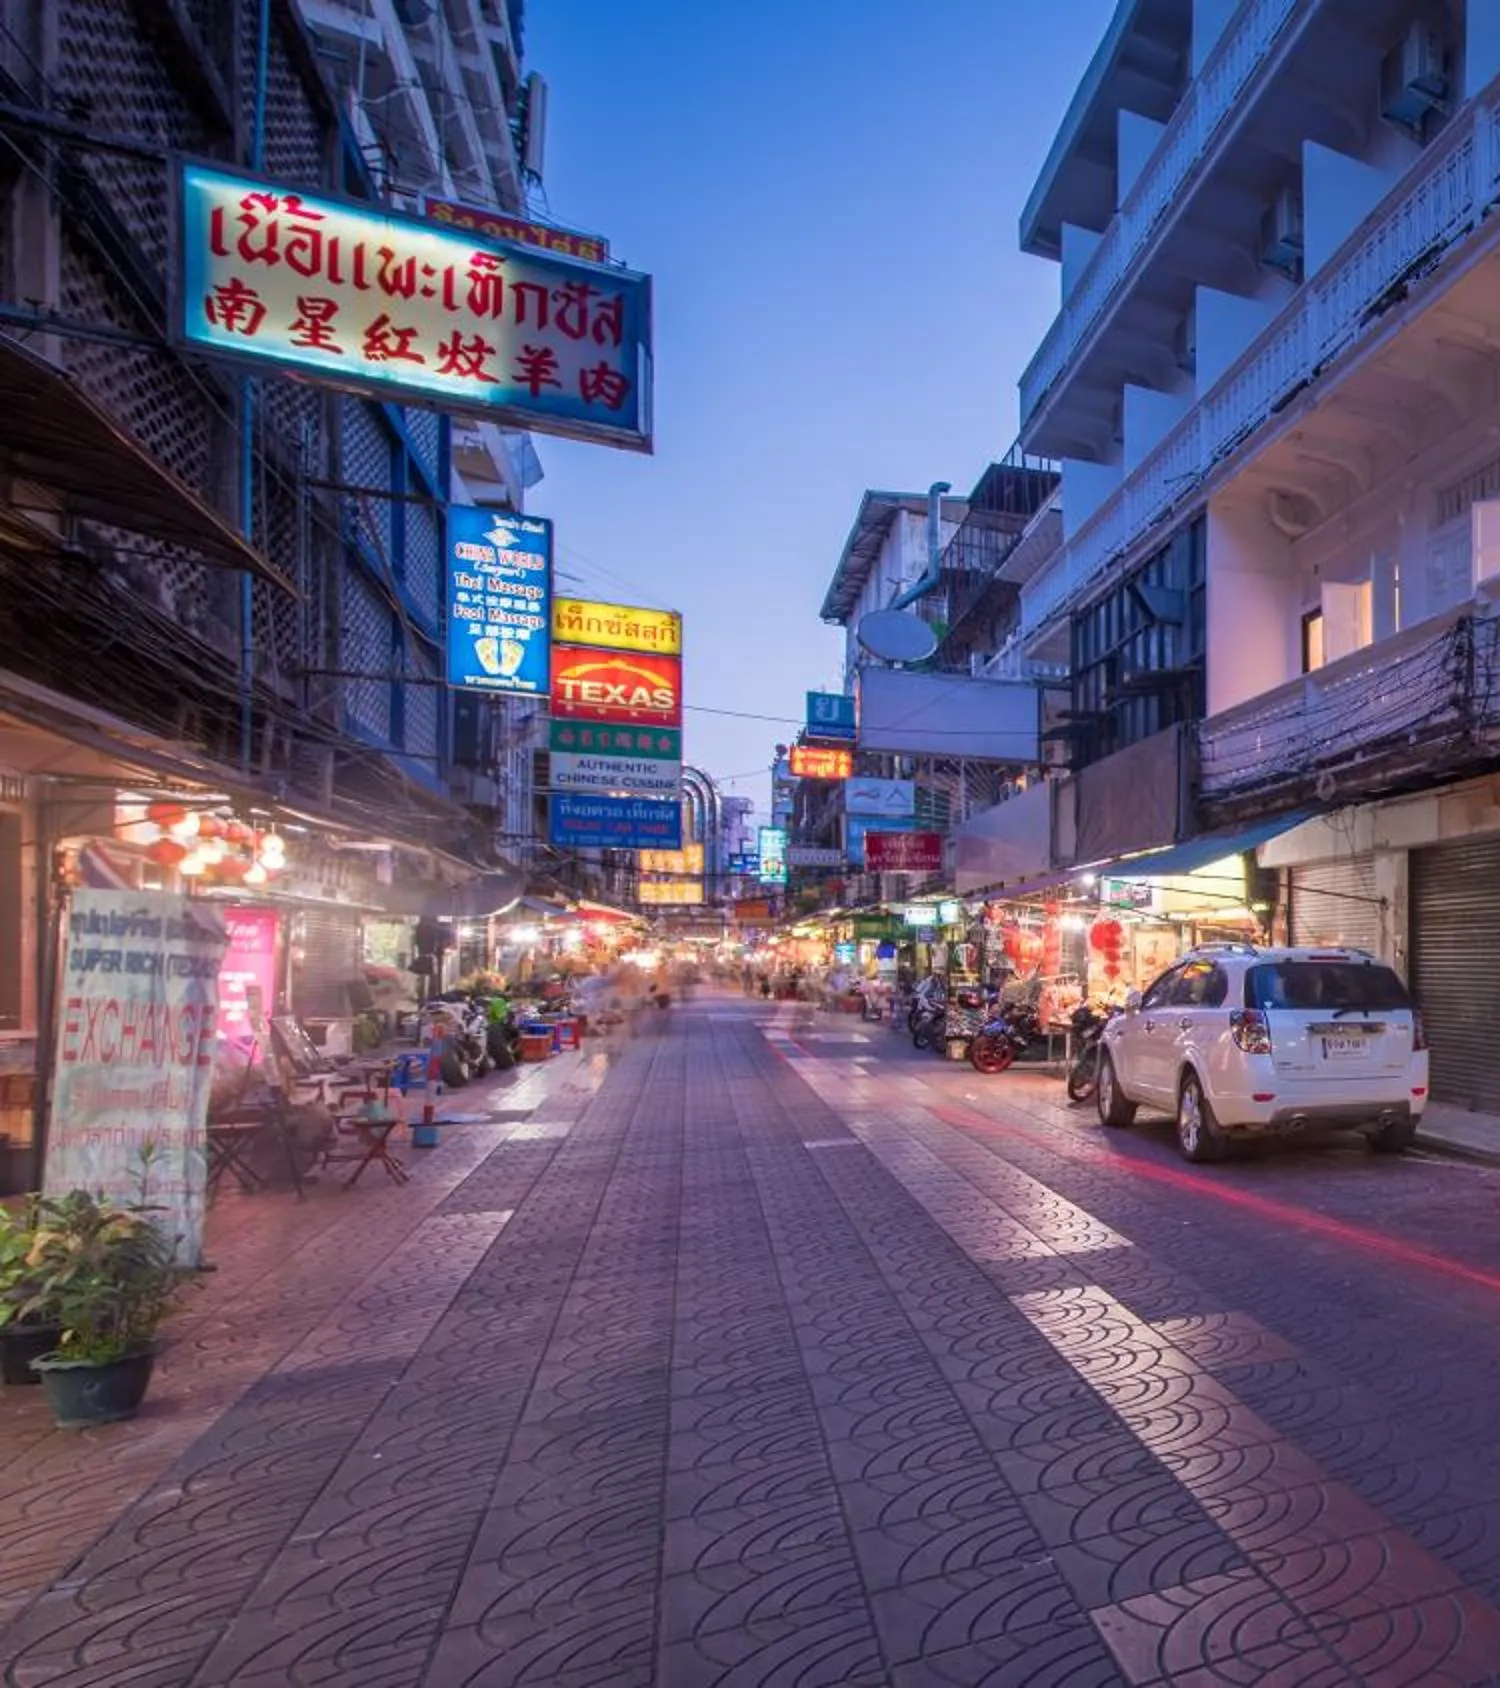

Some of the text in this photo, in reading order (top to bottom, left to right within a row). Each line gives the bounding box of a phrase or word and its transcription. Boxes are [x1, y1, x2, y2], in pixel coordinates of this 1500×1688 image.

[209, 192, 626, 349] เนื้อแพะเท็กซัส
[454, 571, 545, 600] Thai Massage
[487, 607, 546, 631] Massage
[557, 677, 675, 710] TEXAS
[557, 773, 619, 787] CHINESE
[577, 759, 657, 774] AUTHENTIC
[70, 948, 121, 974] SUPER
[62, 998, 216, 1066] EXCHANGE
